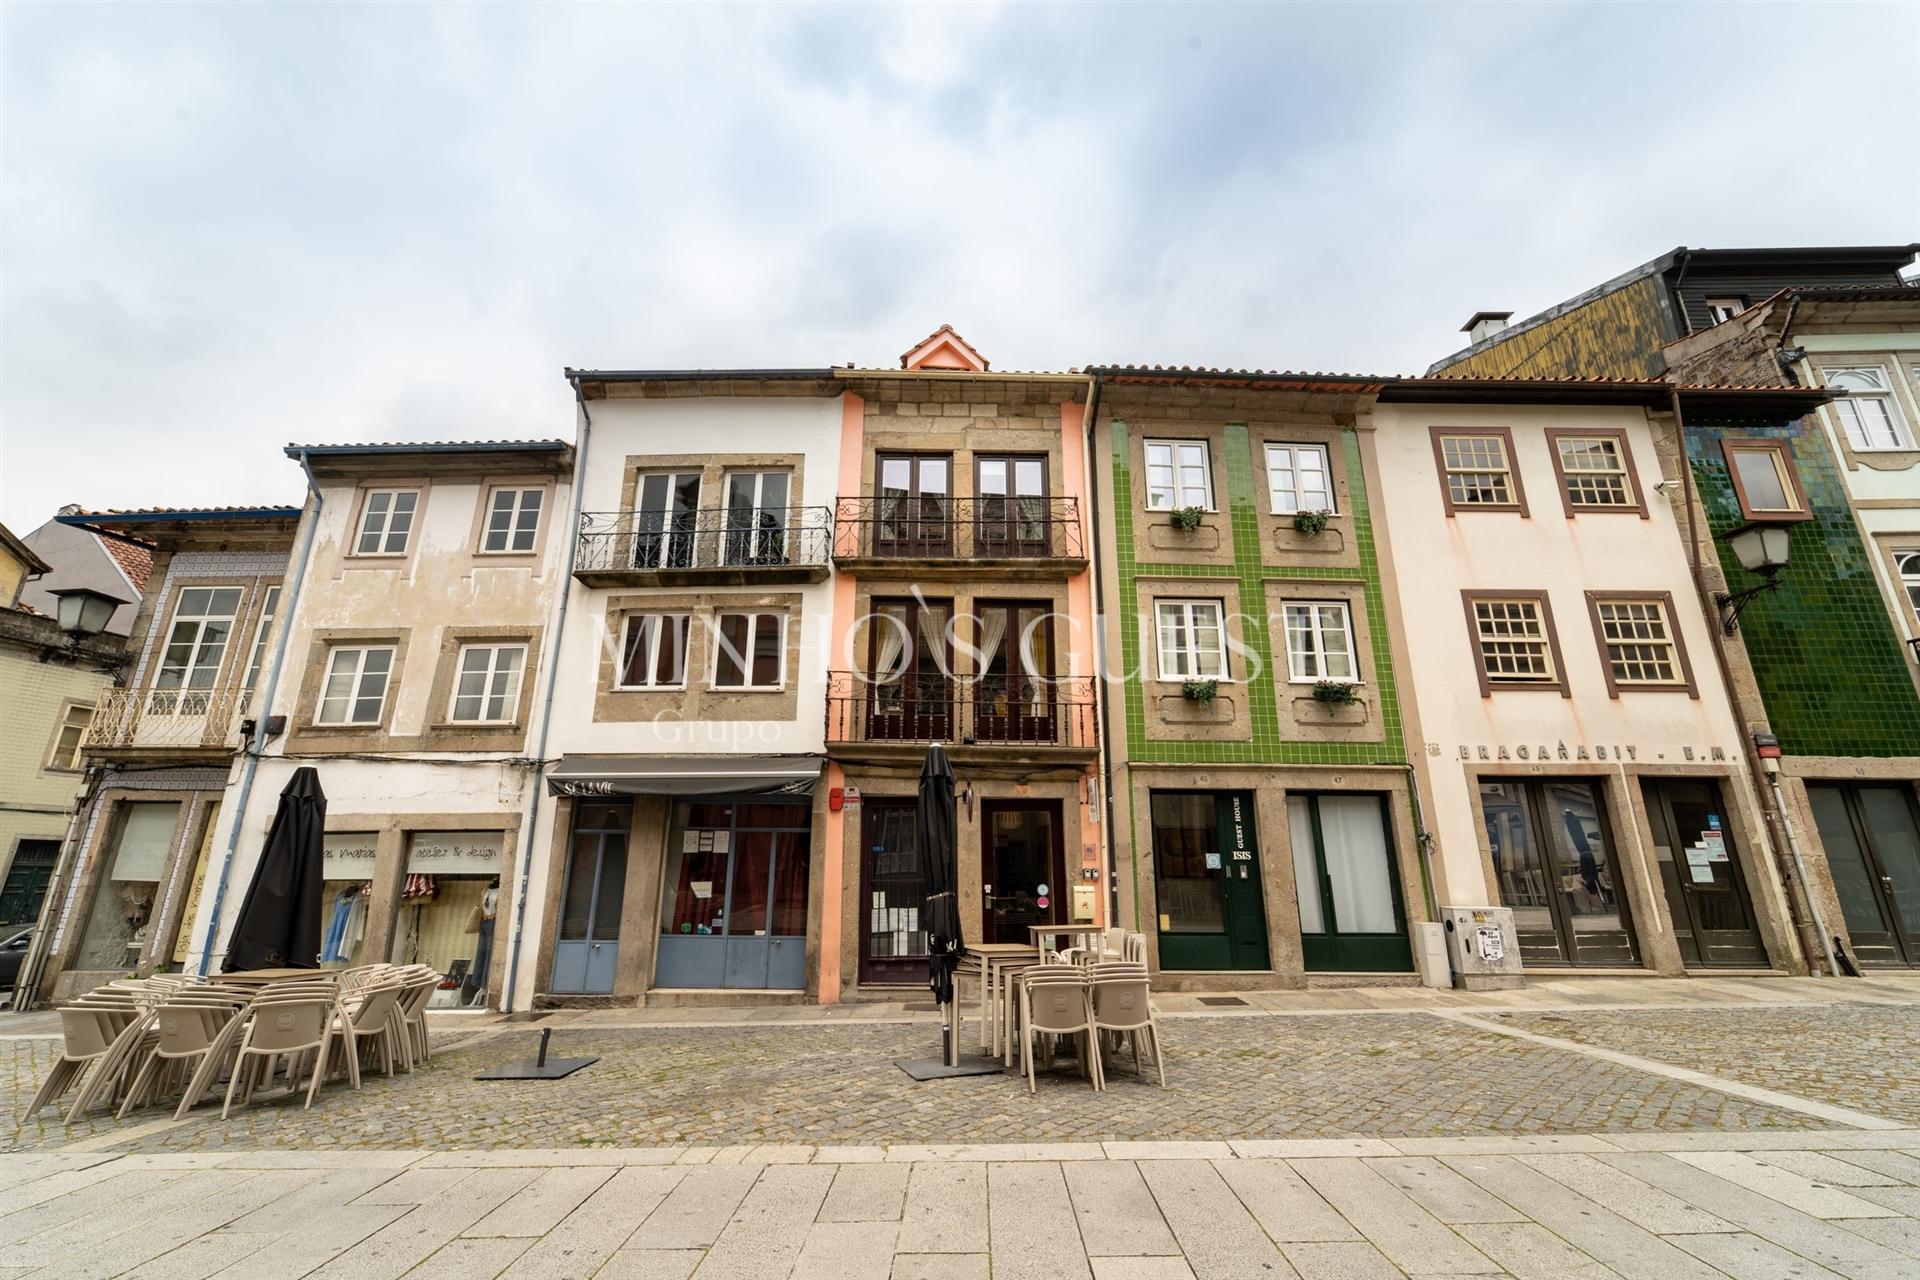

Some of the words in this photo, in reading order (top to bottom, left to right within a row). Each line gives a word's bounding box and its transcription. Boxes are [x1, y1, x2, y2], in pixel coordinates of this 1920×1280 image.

[1232, 796, 1241, 822] HOUSE
[1235, 823, 1244, 849] GUEST
[339, 846, 376, 859] marias
[415, 846, 447, 858] atelier
[452, 847, 462, 857] &
[466, 845, 497, 860] design
[1232, 851, 1252, 861] ISIS
[183, 913, 196, 930] das
